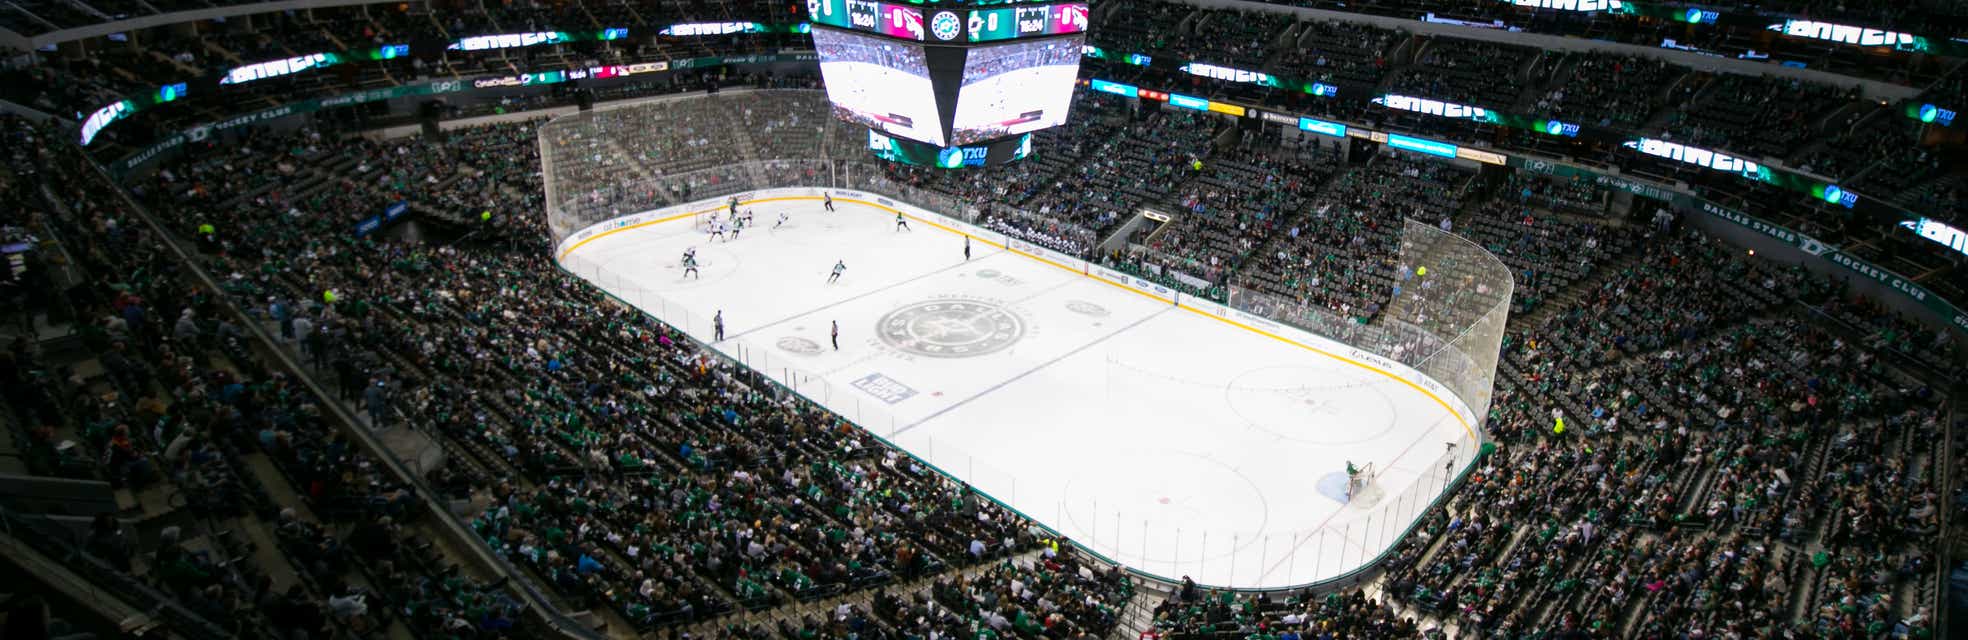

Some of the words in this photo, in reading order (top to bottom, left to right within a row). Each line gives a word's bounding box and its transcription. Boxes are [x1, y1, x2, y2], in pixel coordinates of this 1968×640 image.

[893, 8, 903, 28] 0
[988, 12, 998, 31] 0
[1062, 7, 1071, 25] 0
[963, 147, 988, 159] TXU
[1703, 203, 1750, 225] DALLAS
[1753, 222, 1795, 242] STARS
[1833, 253, 1889, 281] HOCKEY
[1892, 279, 1927, 301] CLUB
